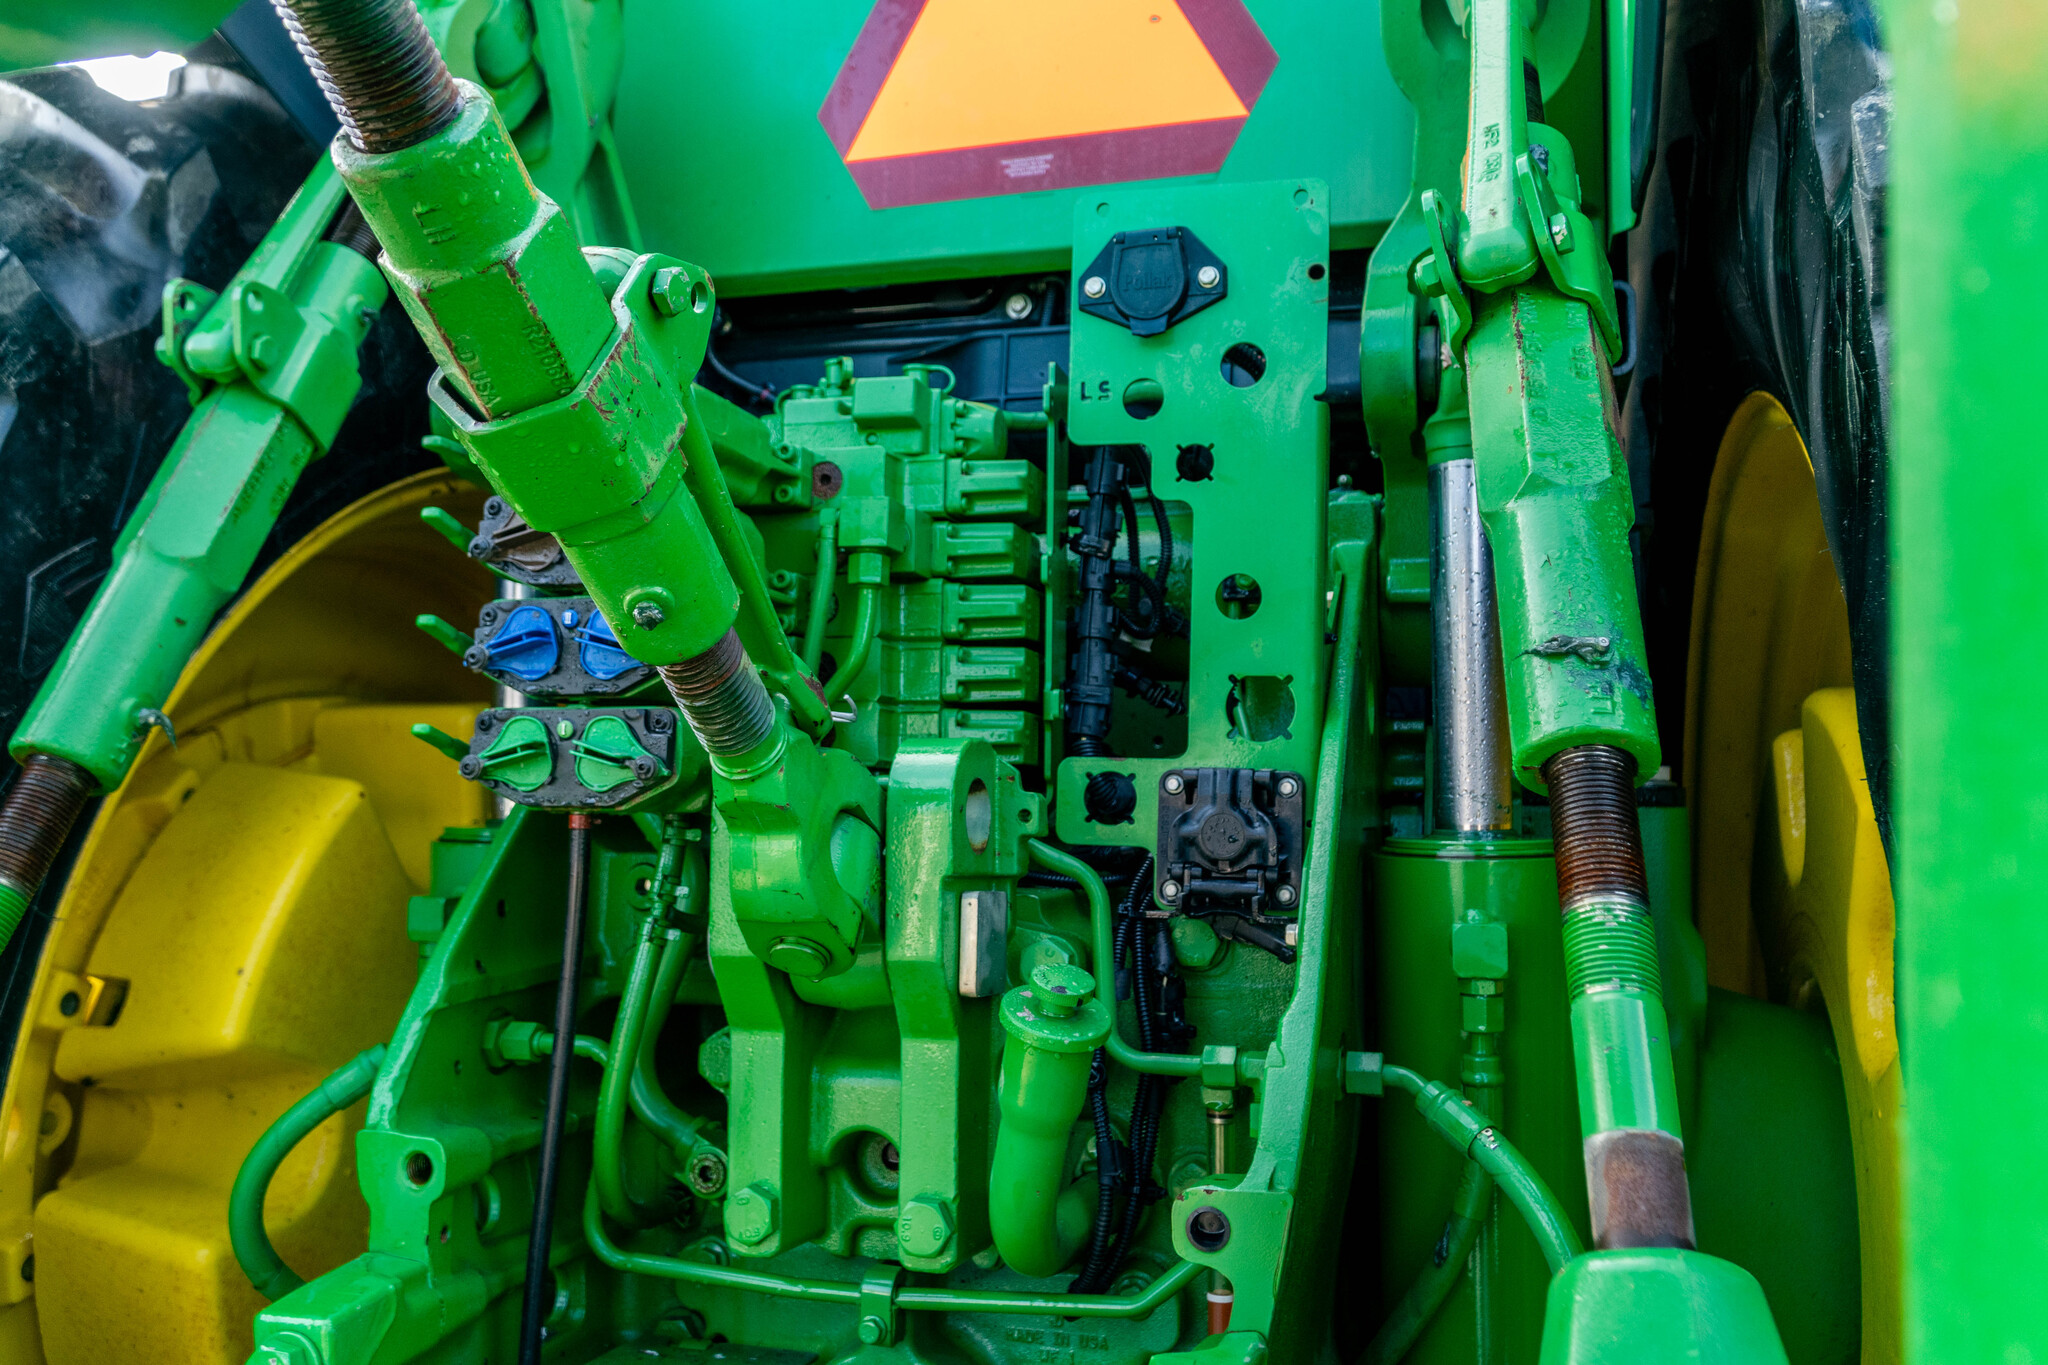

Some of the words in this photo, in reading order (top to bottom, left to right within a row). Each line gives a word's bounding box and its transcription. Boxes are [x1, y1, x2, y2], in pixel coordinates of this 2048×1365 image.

[1123, 271, 1174, 292] Pollak
[470, 370, 501, 407] USA
[1006, 1327, 1044, 1344] MADE
[1054, 1331, 1070, 1347] IN
[1079, 1333, 1109, 1350] USA
